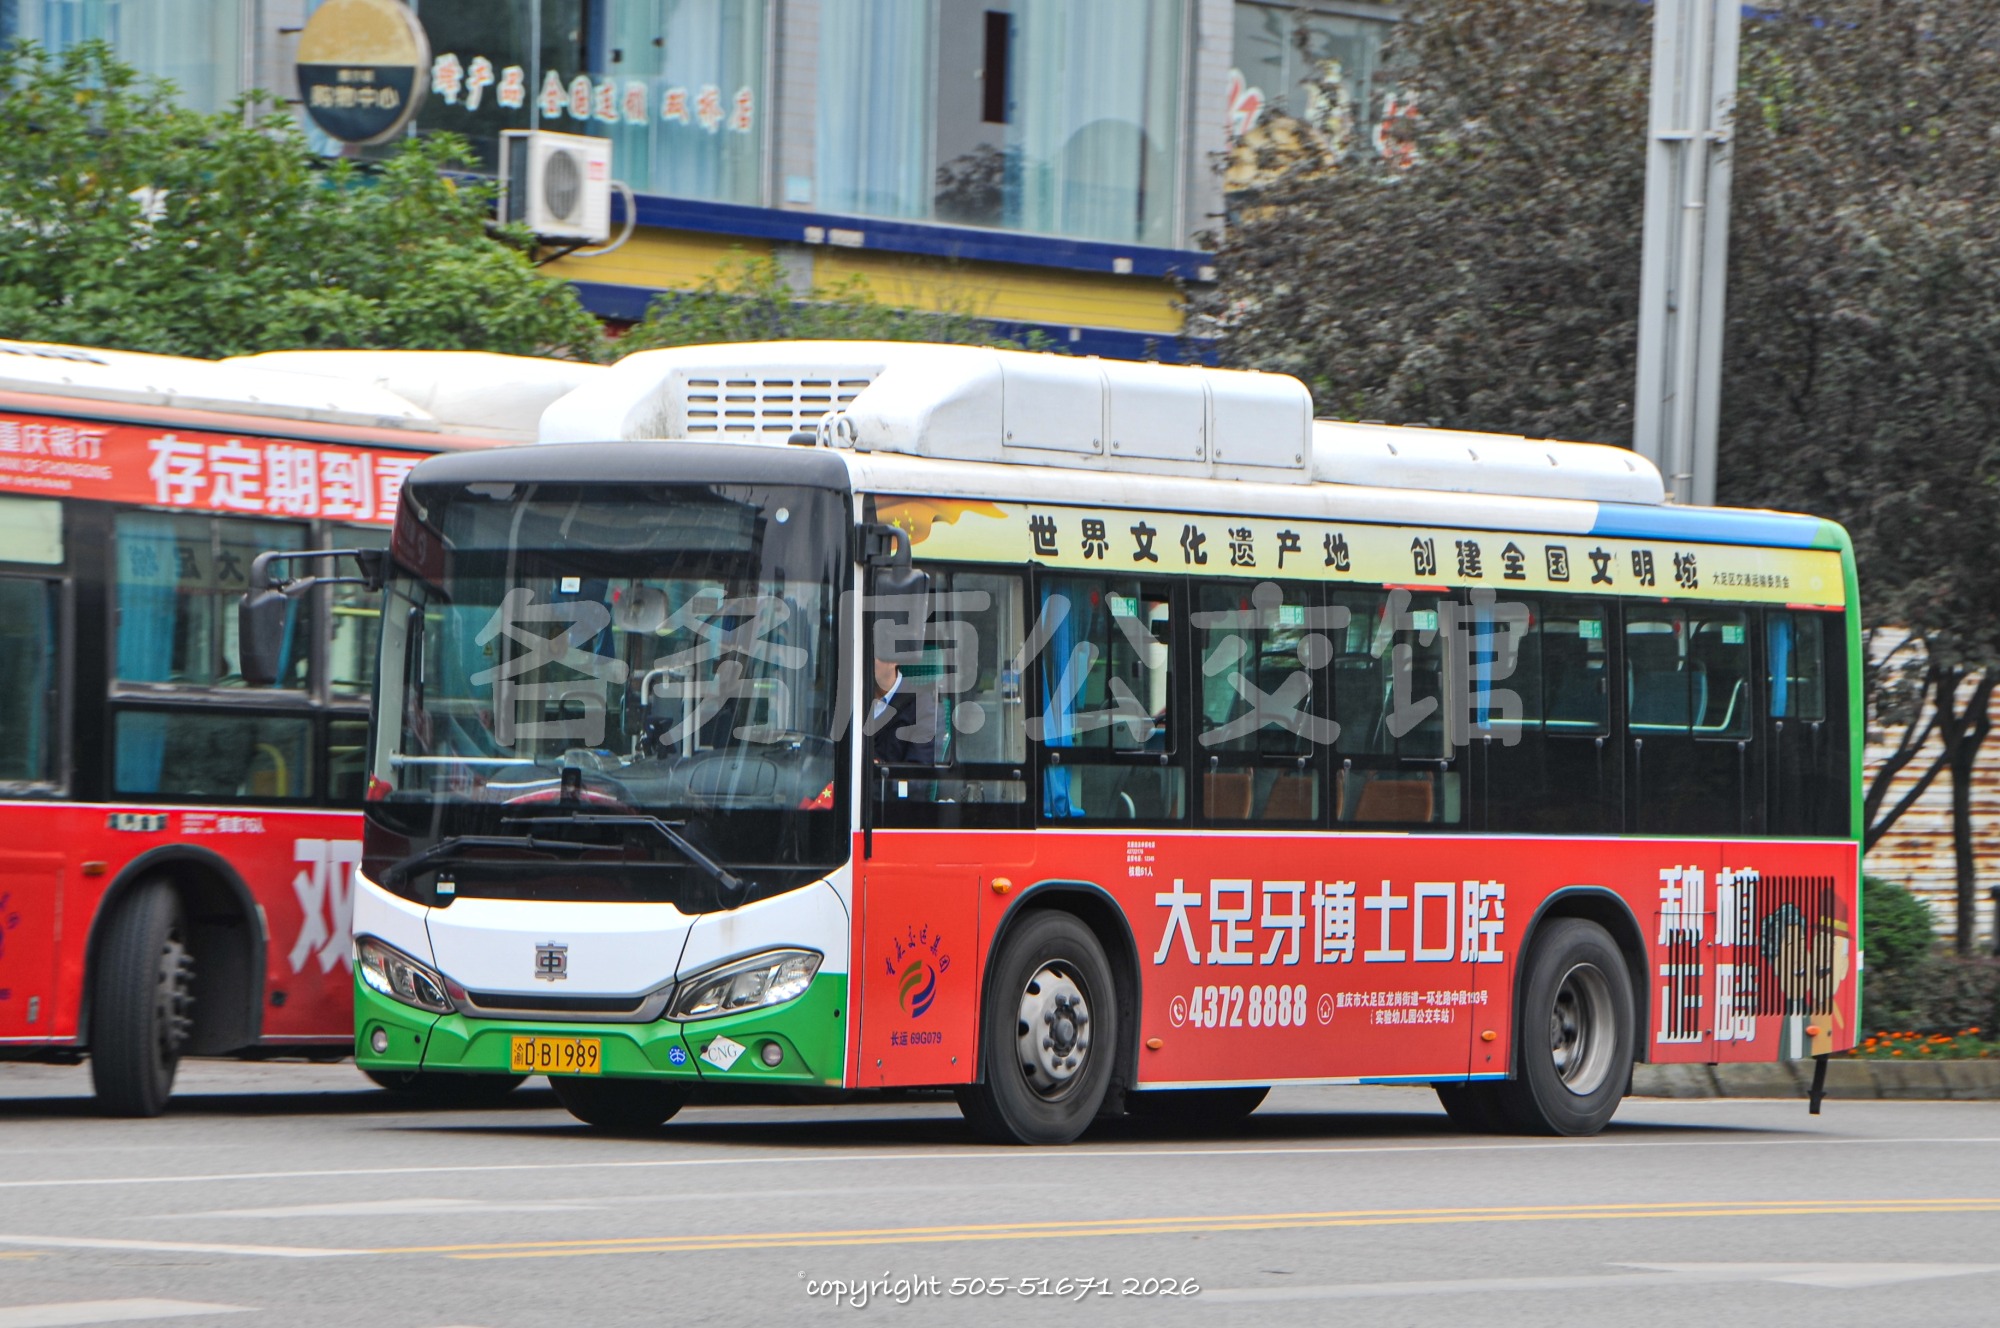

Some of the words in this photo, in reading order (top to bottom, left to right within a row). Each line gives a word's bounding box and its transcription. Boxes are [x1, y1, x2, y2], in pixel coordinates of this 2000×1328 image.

[1028, 514, 1351, 572] 世界文化遗产地
[1410, 536, 1699, 590] 创建全国文明城
[1153, 878, 1506, 966] 大足牙博士口腔
[707, 1044, 738, 1063] CNG
